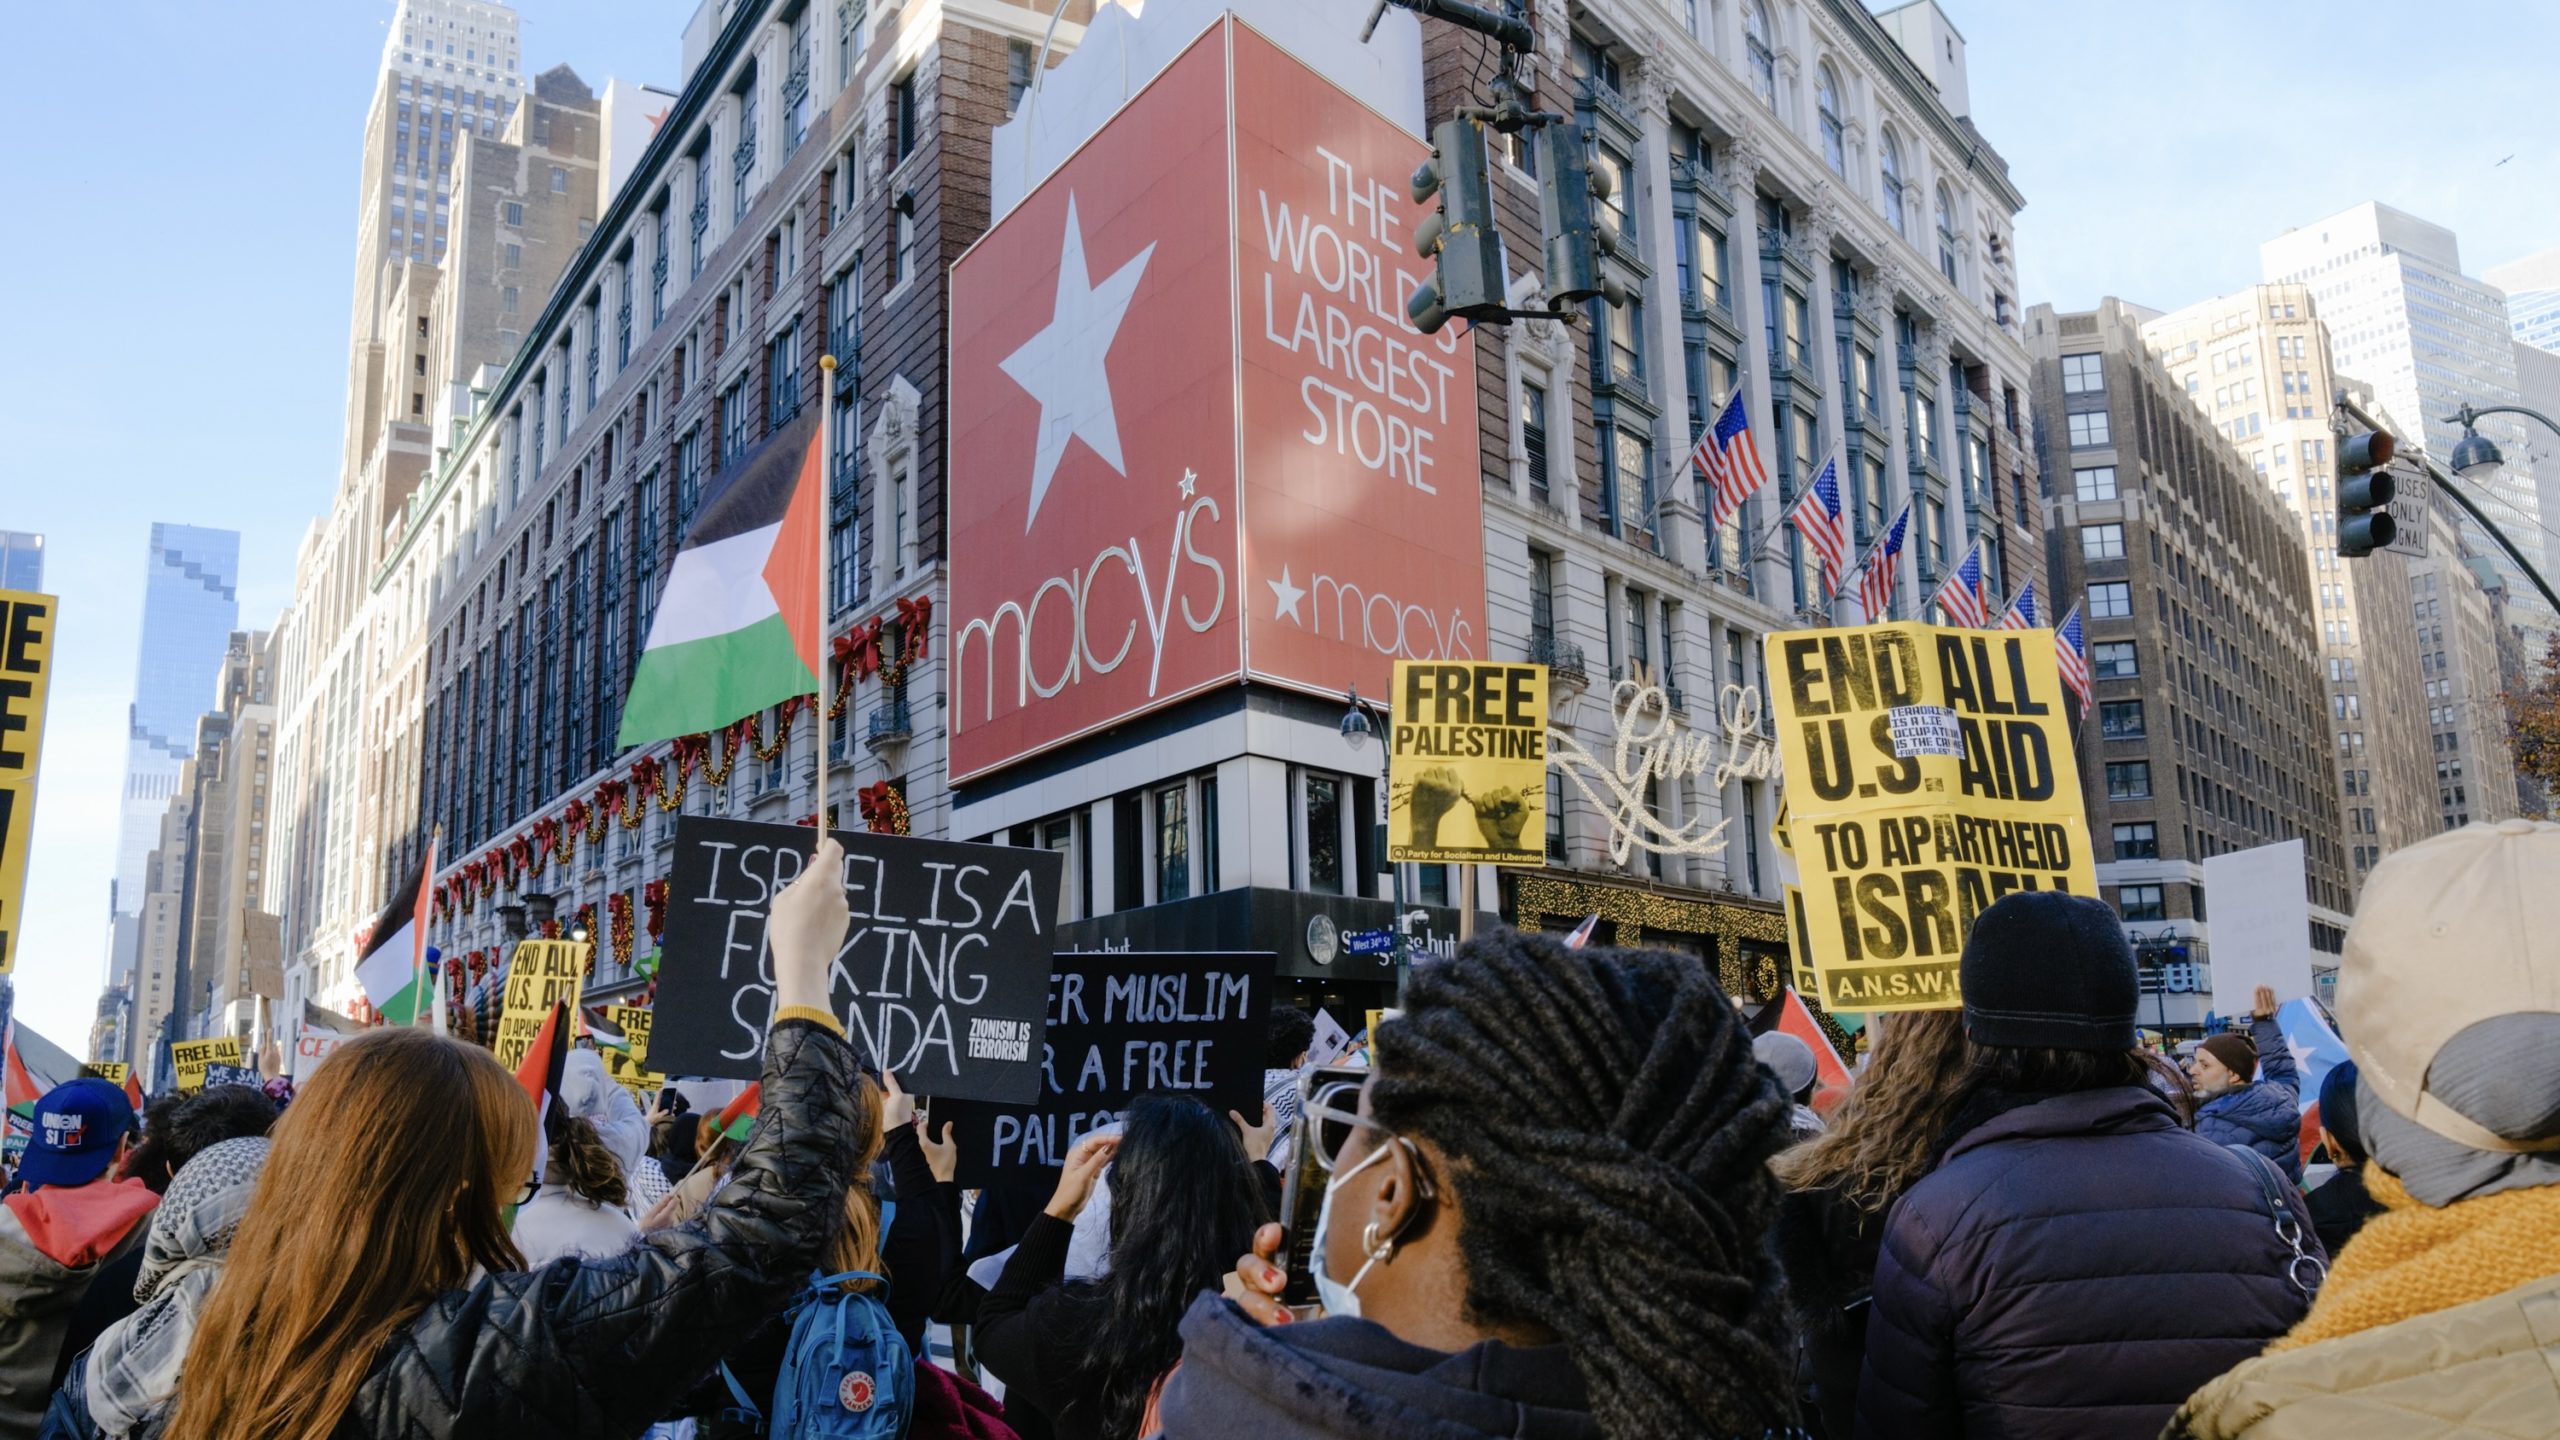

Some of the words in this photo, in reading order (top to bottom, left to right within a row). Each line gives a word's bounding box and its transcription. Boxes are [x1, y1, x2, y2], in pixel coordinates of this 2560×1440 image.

[1316, 145, 1402, 254] THE
[1265, 272, 1454, 424] LARGEST
[1301, 376, 1436, 495] STORE
[2391, 501, 2423, 524] ONLY
[2394, 527, 2423, 549] IGNAL
[1784, 630, 1923, 718] END
[1935, 634, 2050, 716] ALL
[1405, 665, 1536, 728] FREE
[1892, 718, 1907, 728] IS
[1922, 716, 1942, 726] LIE
[1395, 725, 1544, 761] PALESTINE
[1801, 714, 1944, 801] U.S.
[1959, 719, 2055, 801] AID
[1896, 739, 1908, 749] IS
[1910, 738, 1933, 747] THE
[1407, 850, 1429, 860] Party
[1430, 850, 1442, 859] for
[1443, 851, 1484, 860] Socialism
[1485, 852, 1500, 861] and
[1502, 852, 1543, 863] Liberation
[1814, 821, 1869, 872] TO
[1879, 813, 2071, 871] APARTHEID
[694, 841, 906, 923] ISREL
[918, 862, 990, 929] IS
[992, 869, 1041, 935] A
[1353, 940, 1370, 951] West
[1383, 936, 1391, 947] St
[513, 944, 540, 977] END
[508, 977, 533, 1011] U.S.
[1104, 971, 1250, 1025] MUSLIM
[969, 1018, 1017, 1040] ZIONISM
[1019, 1021, 1031, 1041] IS
[175, 1045, 212, 1064] FREE
[215, 1042, 239, 1058] ALL
[968, 1037, 1029, 1062] TERRORISM
[1077, 1045, 1107, 1092] A
[1122, 1040, 1214, 1092] FREE
[208, 1065, 230, 1080] WE
[42, 1112, 82, 1130] UNION
[46, 1130, 59, 1145] SI
